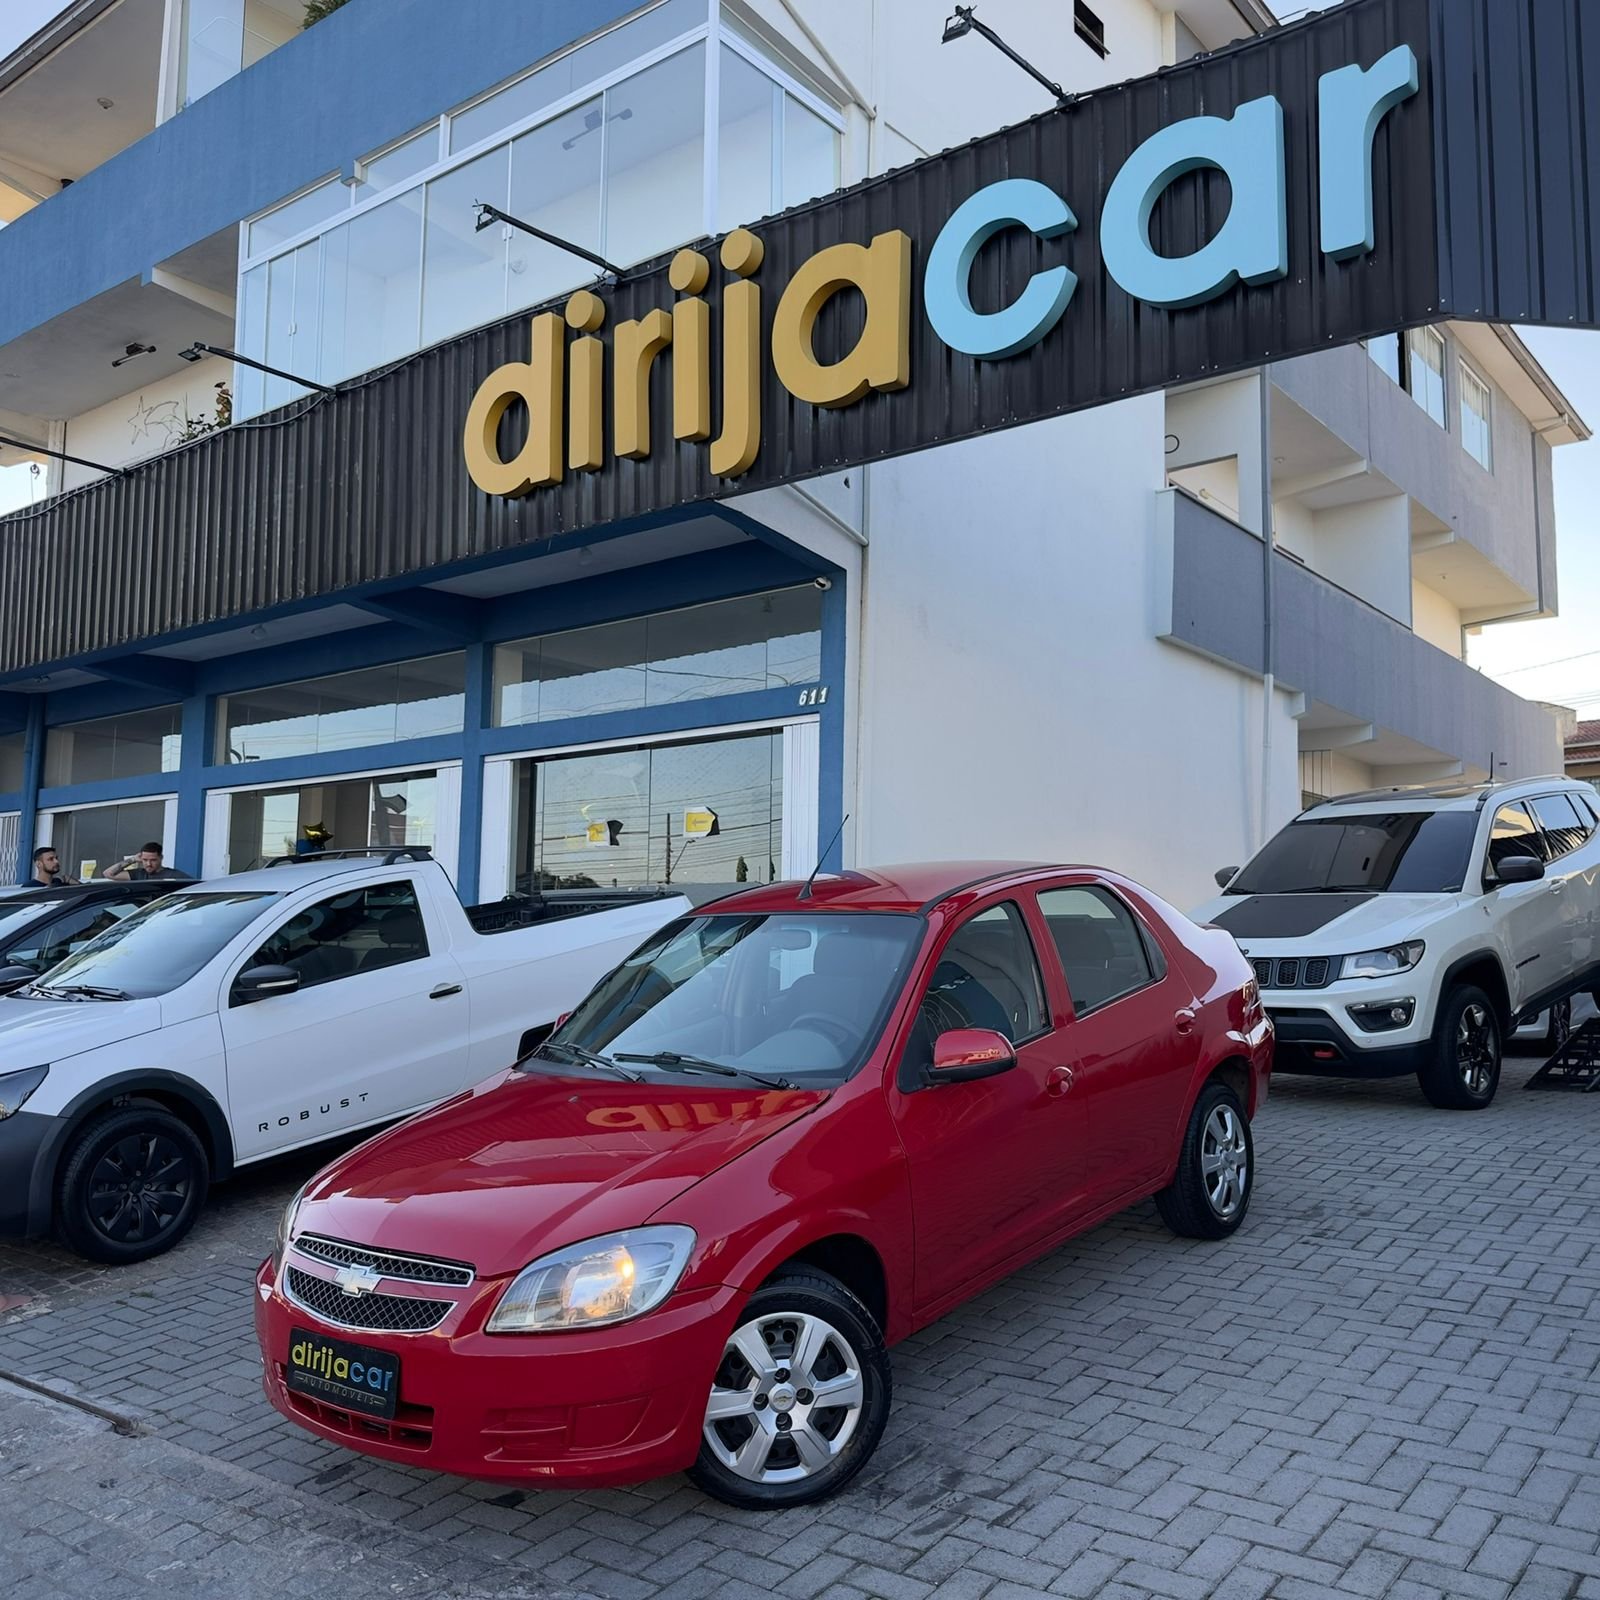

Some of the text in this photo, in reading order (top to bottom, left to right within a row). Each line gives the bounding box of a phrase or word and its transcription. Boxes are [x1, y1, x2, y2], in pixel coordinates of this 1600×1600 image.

[463, 44, 1419, 499] dirijacar
[798, 687, 828, 706] 611
[258, 1092, 369, 1132] ROBUST
[291, 1340, 393, 1392] dirijacar
